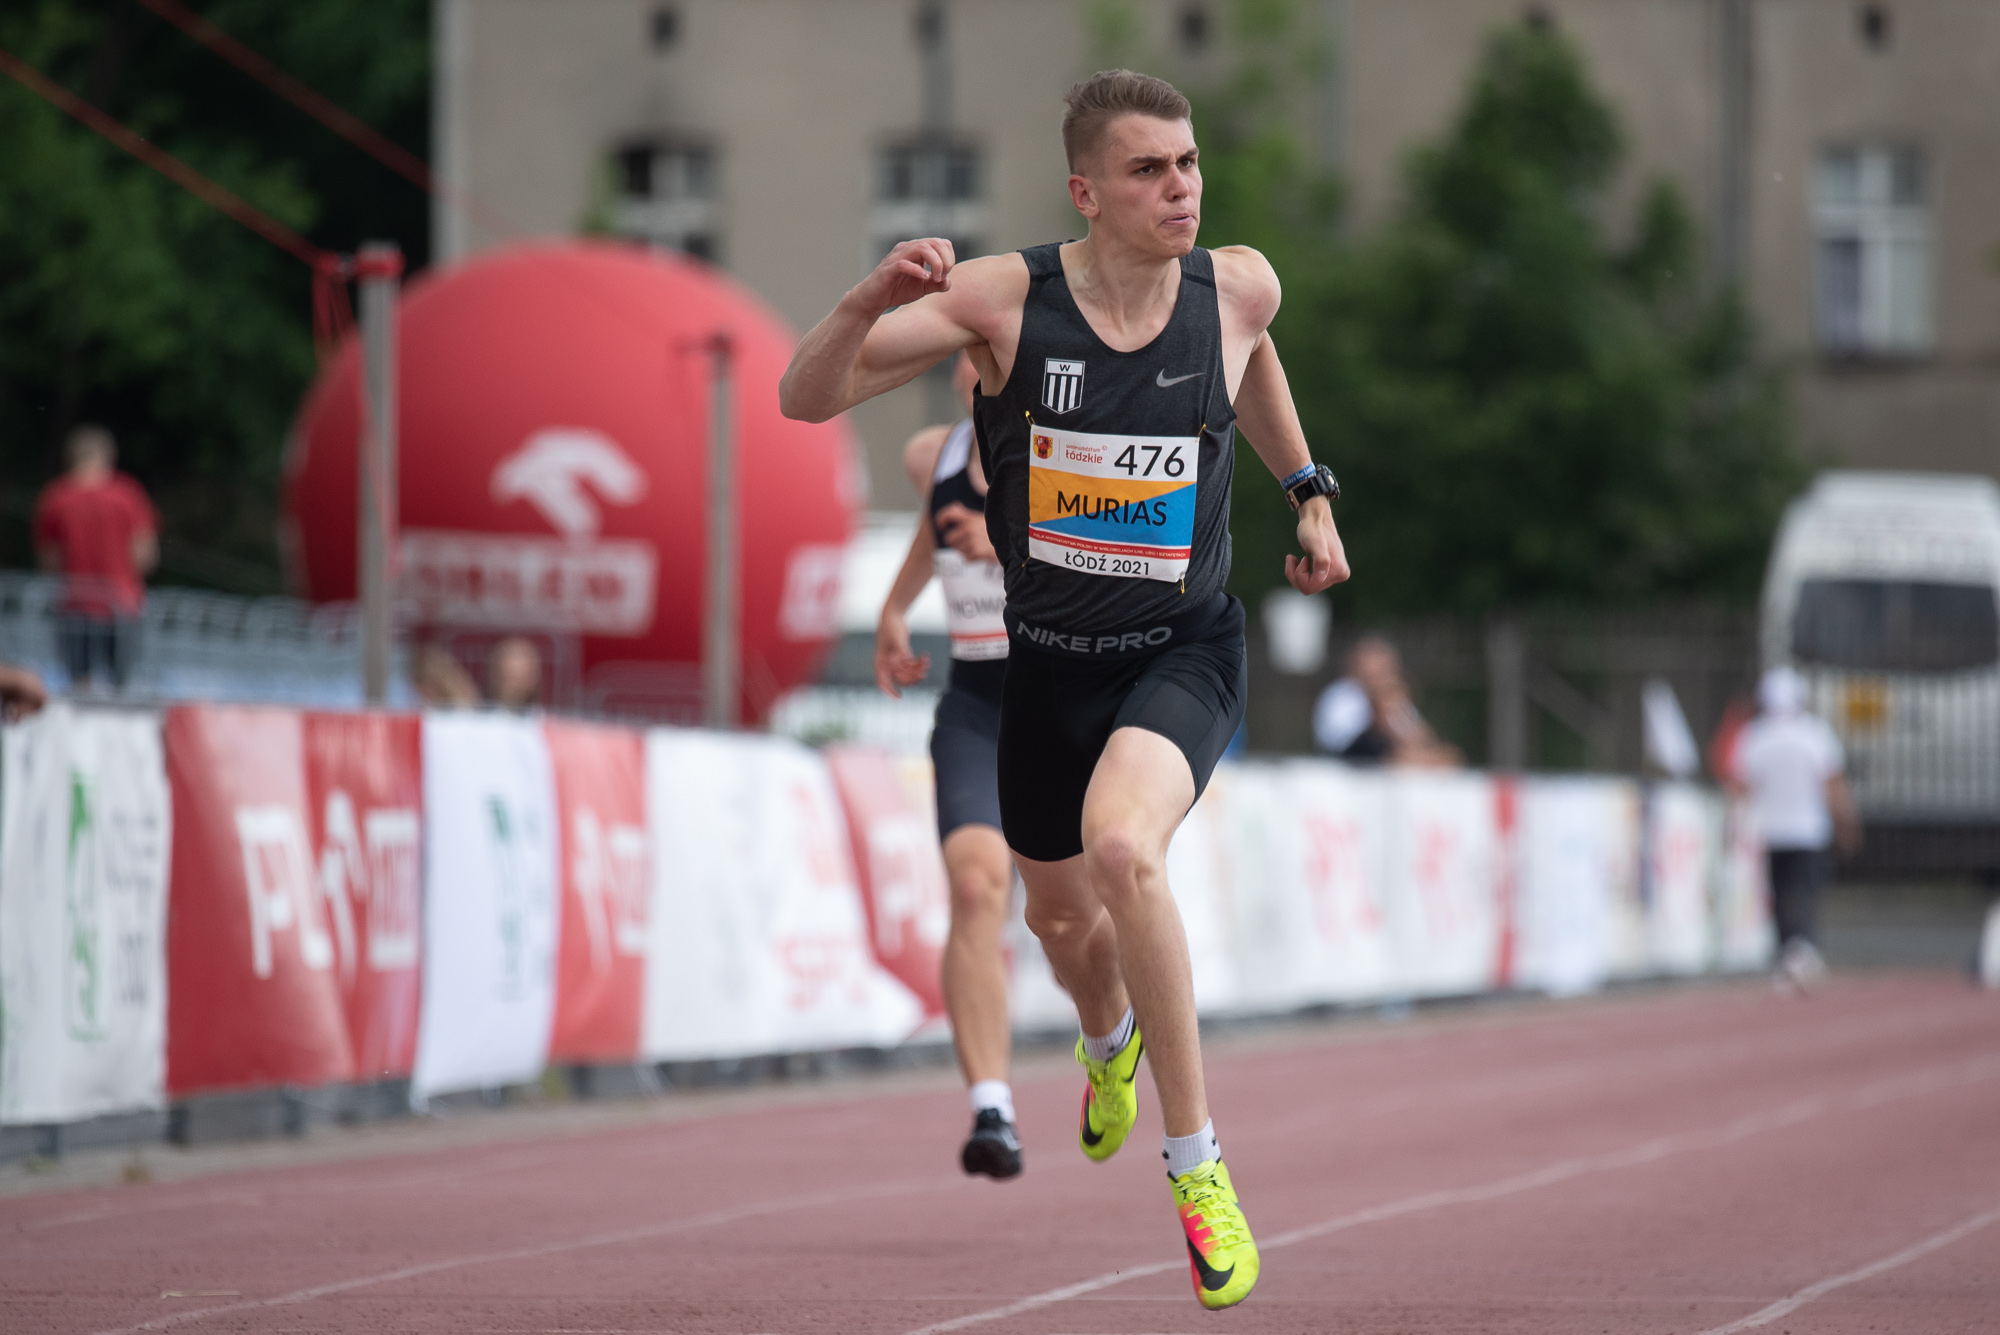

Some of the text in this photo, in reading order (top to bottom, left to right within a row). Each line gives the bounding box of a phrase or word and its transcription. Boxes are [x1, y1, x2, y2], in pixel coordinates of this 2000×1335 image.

[1059, 364, 1071, 372] W
[1065, 449, 1103, 464] łódzkie
[1114, 444, 1185, 478] 476
[1057, 490, 1168, 527] MURIAS
[1064, 550, 1150, 576] ŁÓDŹ 2021
[1016, 621, 1092, 653] NIKE
[1094, 626, 1173, 654] PRO
